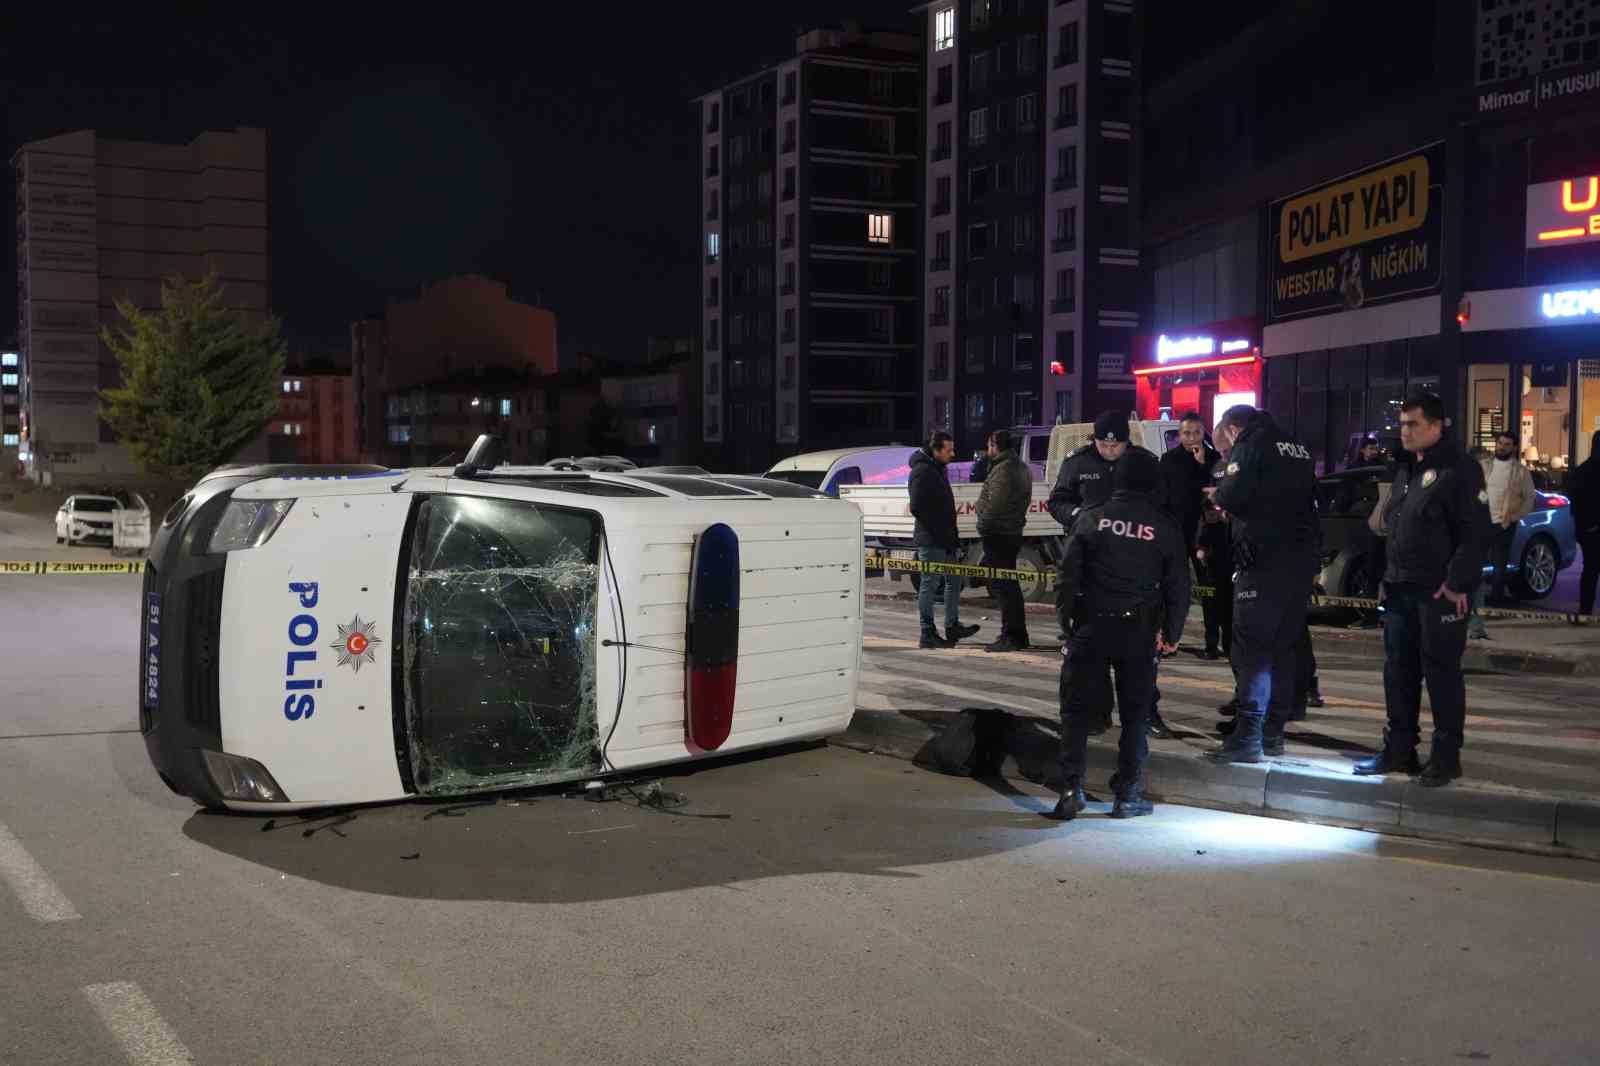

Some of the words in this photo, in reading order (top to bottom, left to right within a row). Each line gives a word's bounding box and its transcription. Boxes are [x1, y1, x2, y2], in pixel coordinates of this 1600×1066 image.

[1479, 89, 1532, 112] Mimar
[1289, 191, 1355, 251] POLAT
[1360, 170, 1417, 230] YAPI
[1277, 266, 1336, 302] WEBSTAR
[1369, 240, 1429, 281] NİĞKİM
[1097, 518, 1155, 541] POLIS
[149, 633, 160, 648] A
[284, 582, 322, 721] POLİS
